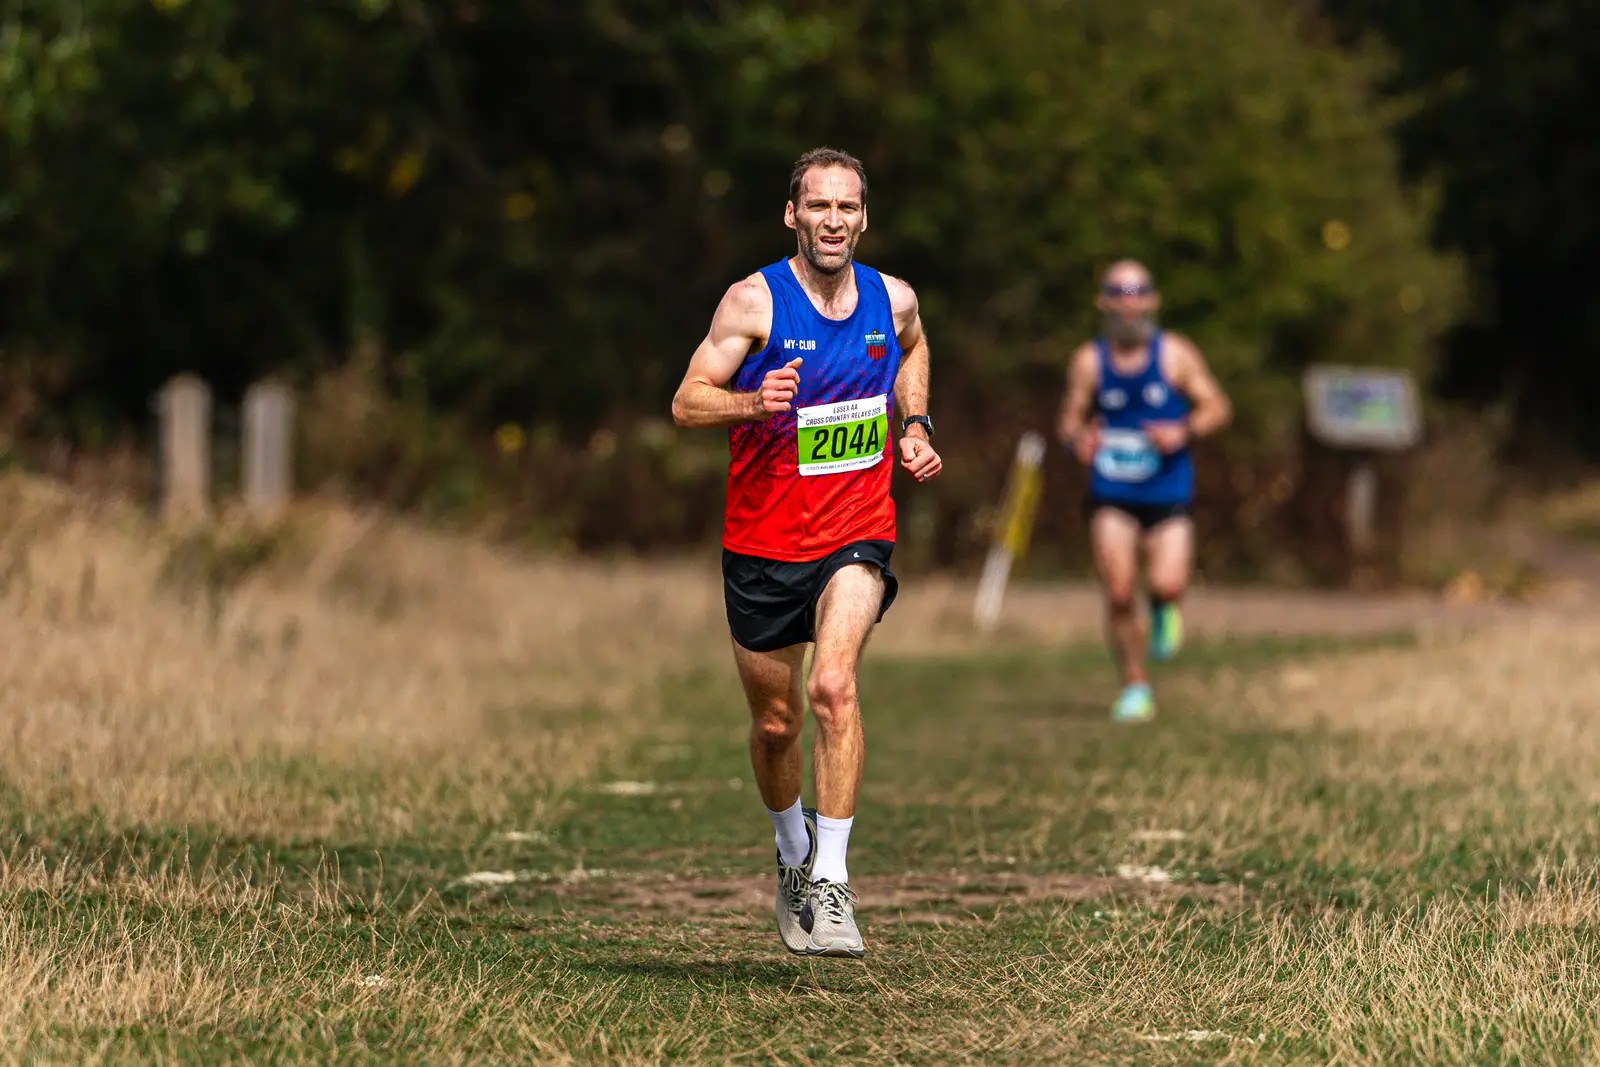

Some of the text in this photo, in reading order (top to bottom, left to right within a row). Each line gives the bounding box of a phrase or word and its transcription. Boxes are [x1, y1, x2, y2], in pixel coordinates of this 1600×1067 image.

[833, 403, 858, 414] ESSEX AA
[805, 417, 825, 426] CROSS
[825, 413, 850, 423] COUNTRY
[850, 409, 871, 419] RELAYS
[811, 420, 879, 461] 204A
